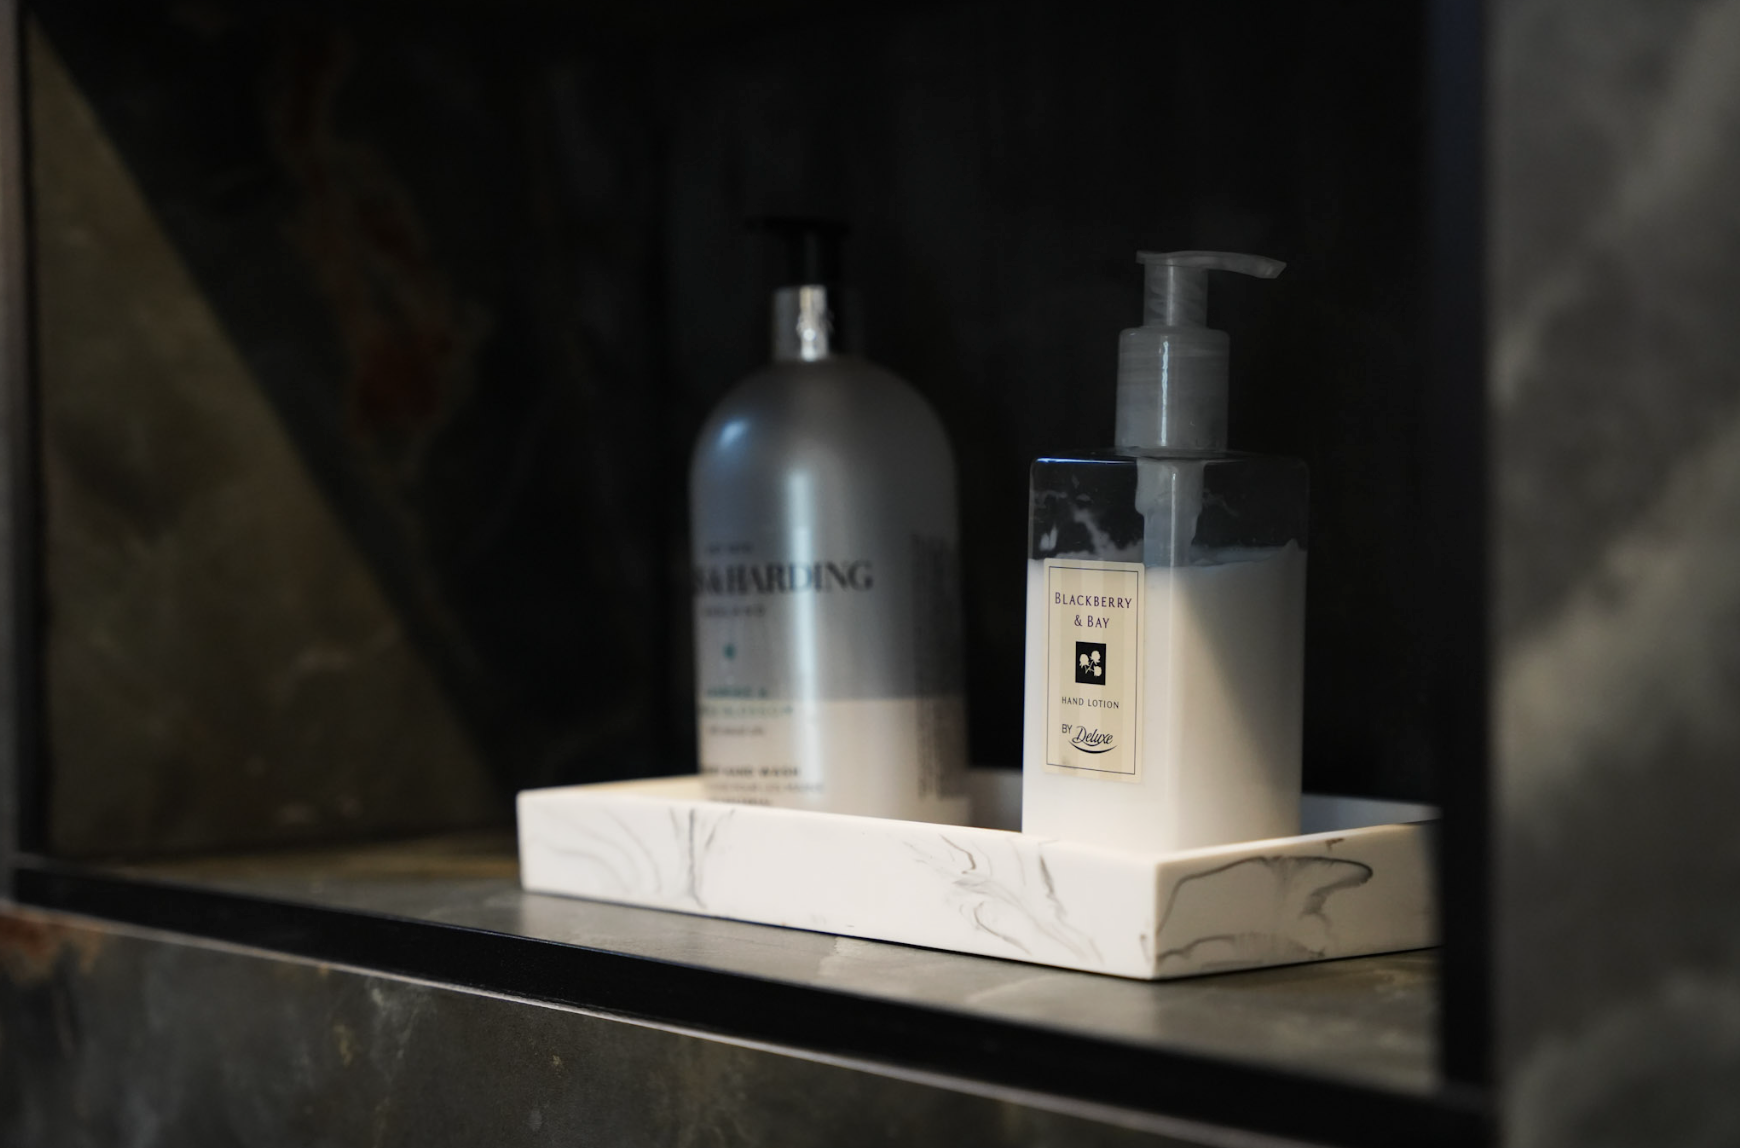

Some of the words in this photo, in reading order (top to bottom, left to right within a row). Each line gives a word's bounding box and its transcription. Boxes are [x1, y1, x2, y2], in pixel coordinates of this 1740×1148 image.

[1054, 591, 1132, 609] BLACKBERRY
[1074, 614, 1083, 627] &
[1087, 614, 1110, 629] BAY
[1061, 696, 1085, 706] HAND
[1087, 698, 1120, 710] LOTION
[1061, 723, 1073, 735] BY
[1071, 725, 1114, 747] Deluxe
